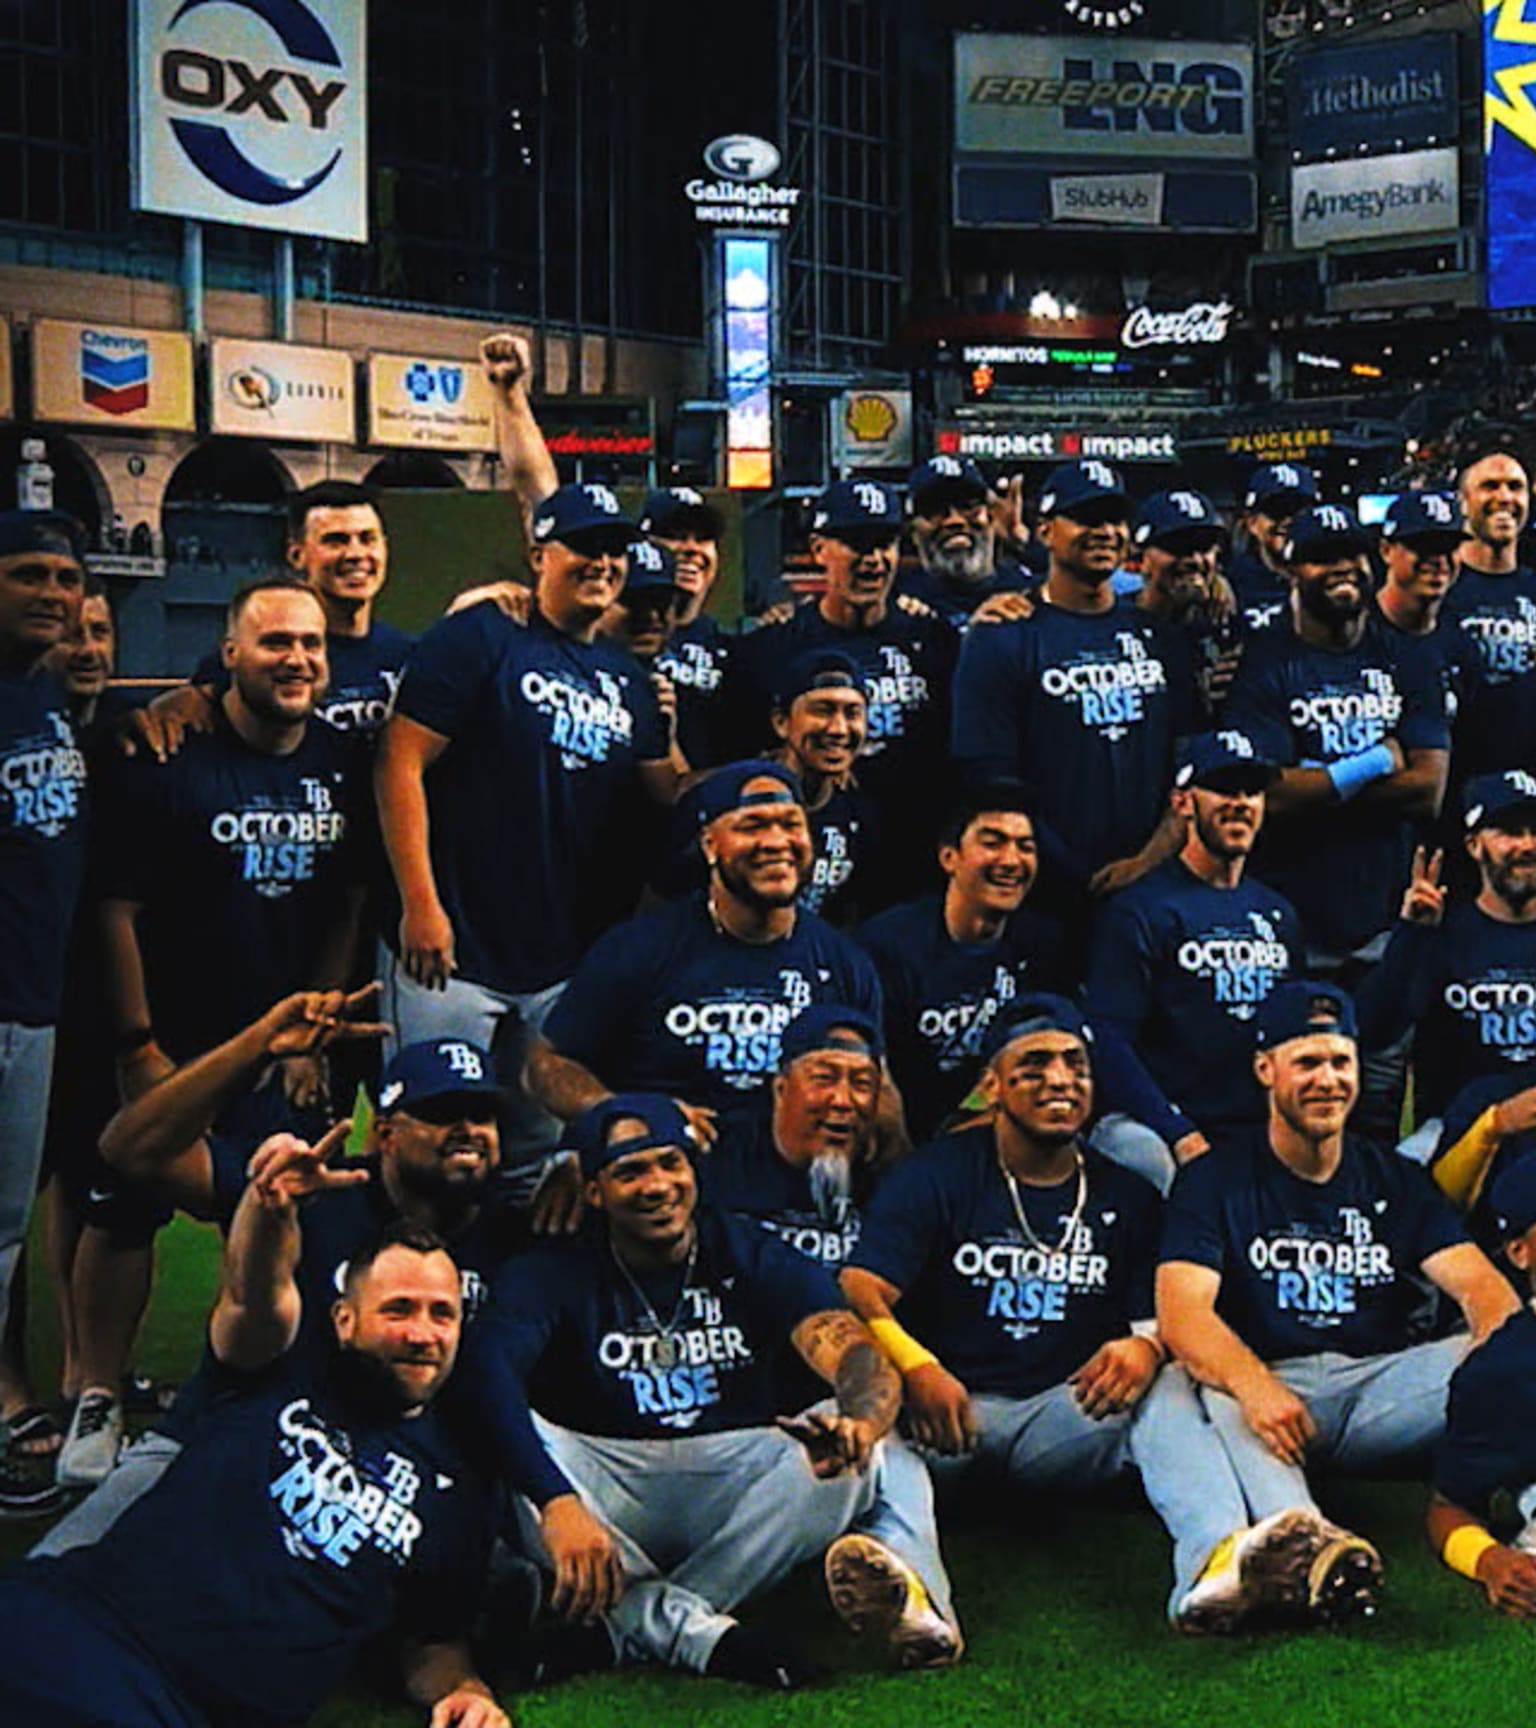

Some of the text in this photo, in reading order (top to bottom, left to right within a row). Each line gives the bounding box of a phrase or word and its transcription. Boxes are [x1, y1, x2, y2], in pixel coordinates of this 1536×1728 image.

[161, 49, 346, 129] OXY
[968, 59, 1244, 135] FREEPORT LNG
[685, 180, 799, 206] Gallagher
[1065, 187, 1149, 209] StubHub
[695, 206, 790, 225] INSURANCE
[81, 330, 148, 351] Chevron
[959, 433, 1054, 459] impact
[1082, 433, 1176, 459] impact
[1081, 460, 1114, 487] TB
[584, 485, 620, 514] TB
[854, 485, 886, 514] TB
[1170, 492, 1205, 519] TB
[1421, 493, 1452, 523] TB
[628, 542, 663, 571] TB
[880, 646, 912, 675] TB
[1116, 632, 1146, 661] TB
[1042, 659, 1168, 695] OCTOBER
[1361, 669, 1394, 693] TB
[521, 671, 633, 740] OCTOBER
[1082, 688, 1145, 727] RISE
[551, 706, 611, 764] RISE
[1218, 729, 1253, 757] TB
[1320, 719, 1387, 756] RISE
[13, 780, 82, 826] RISE
[302, 778, 332, 811] TB
[212, 812, 345, 844] OCTOBER
[823, 827, 847, 858] TB
[243, 843, 316, 881] RISE
[1178, 940, 1289, 971] OCTOBER
[780, 970, 811, 1008] TB
[440, 1043, 484, 1081] TB
[1338, 1207, 1374, 1245] TB
[954, 1242, 1110, 1287] OCTOBER
[1249, 1235, 1394, 1277] OCTOBER
[684, 1287, 722, 1327] TB
[1276, 1270, 1358, 1314] RISE
[630, 1362, 721, 1416] RISE
[381, 1451, 421, 1505] TB
[268, 1457, 371, 1568] RISE
